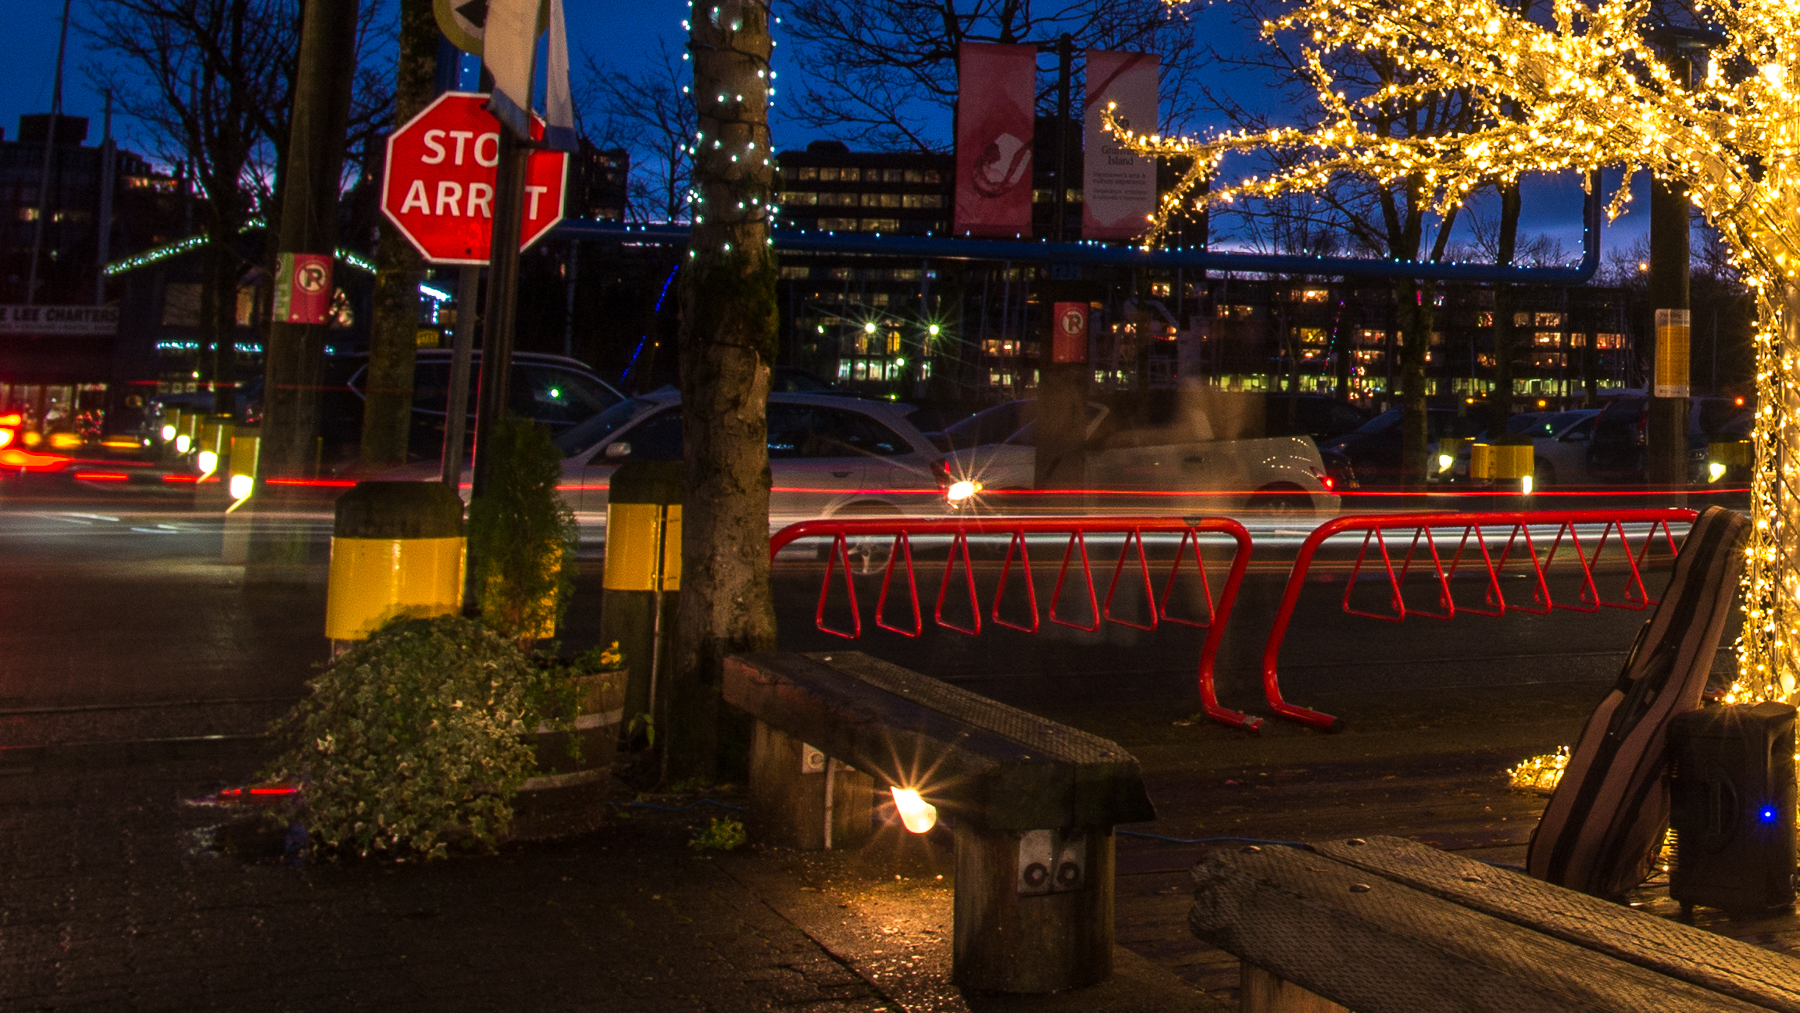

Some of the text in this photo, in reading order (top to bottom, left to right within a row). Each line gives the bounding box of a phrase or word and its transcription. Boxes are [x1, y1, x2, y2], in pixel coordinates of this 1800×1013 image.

[421, 129, 500, 168] STO
[1108, 156, 1134, 166] Island
[400, 179, 548, 220] ARRT
[13, 308, 39, 322] LEE
